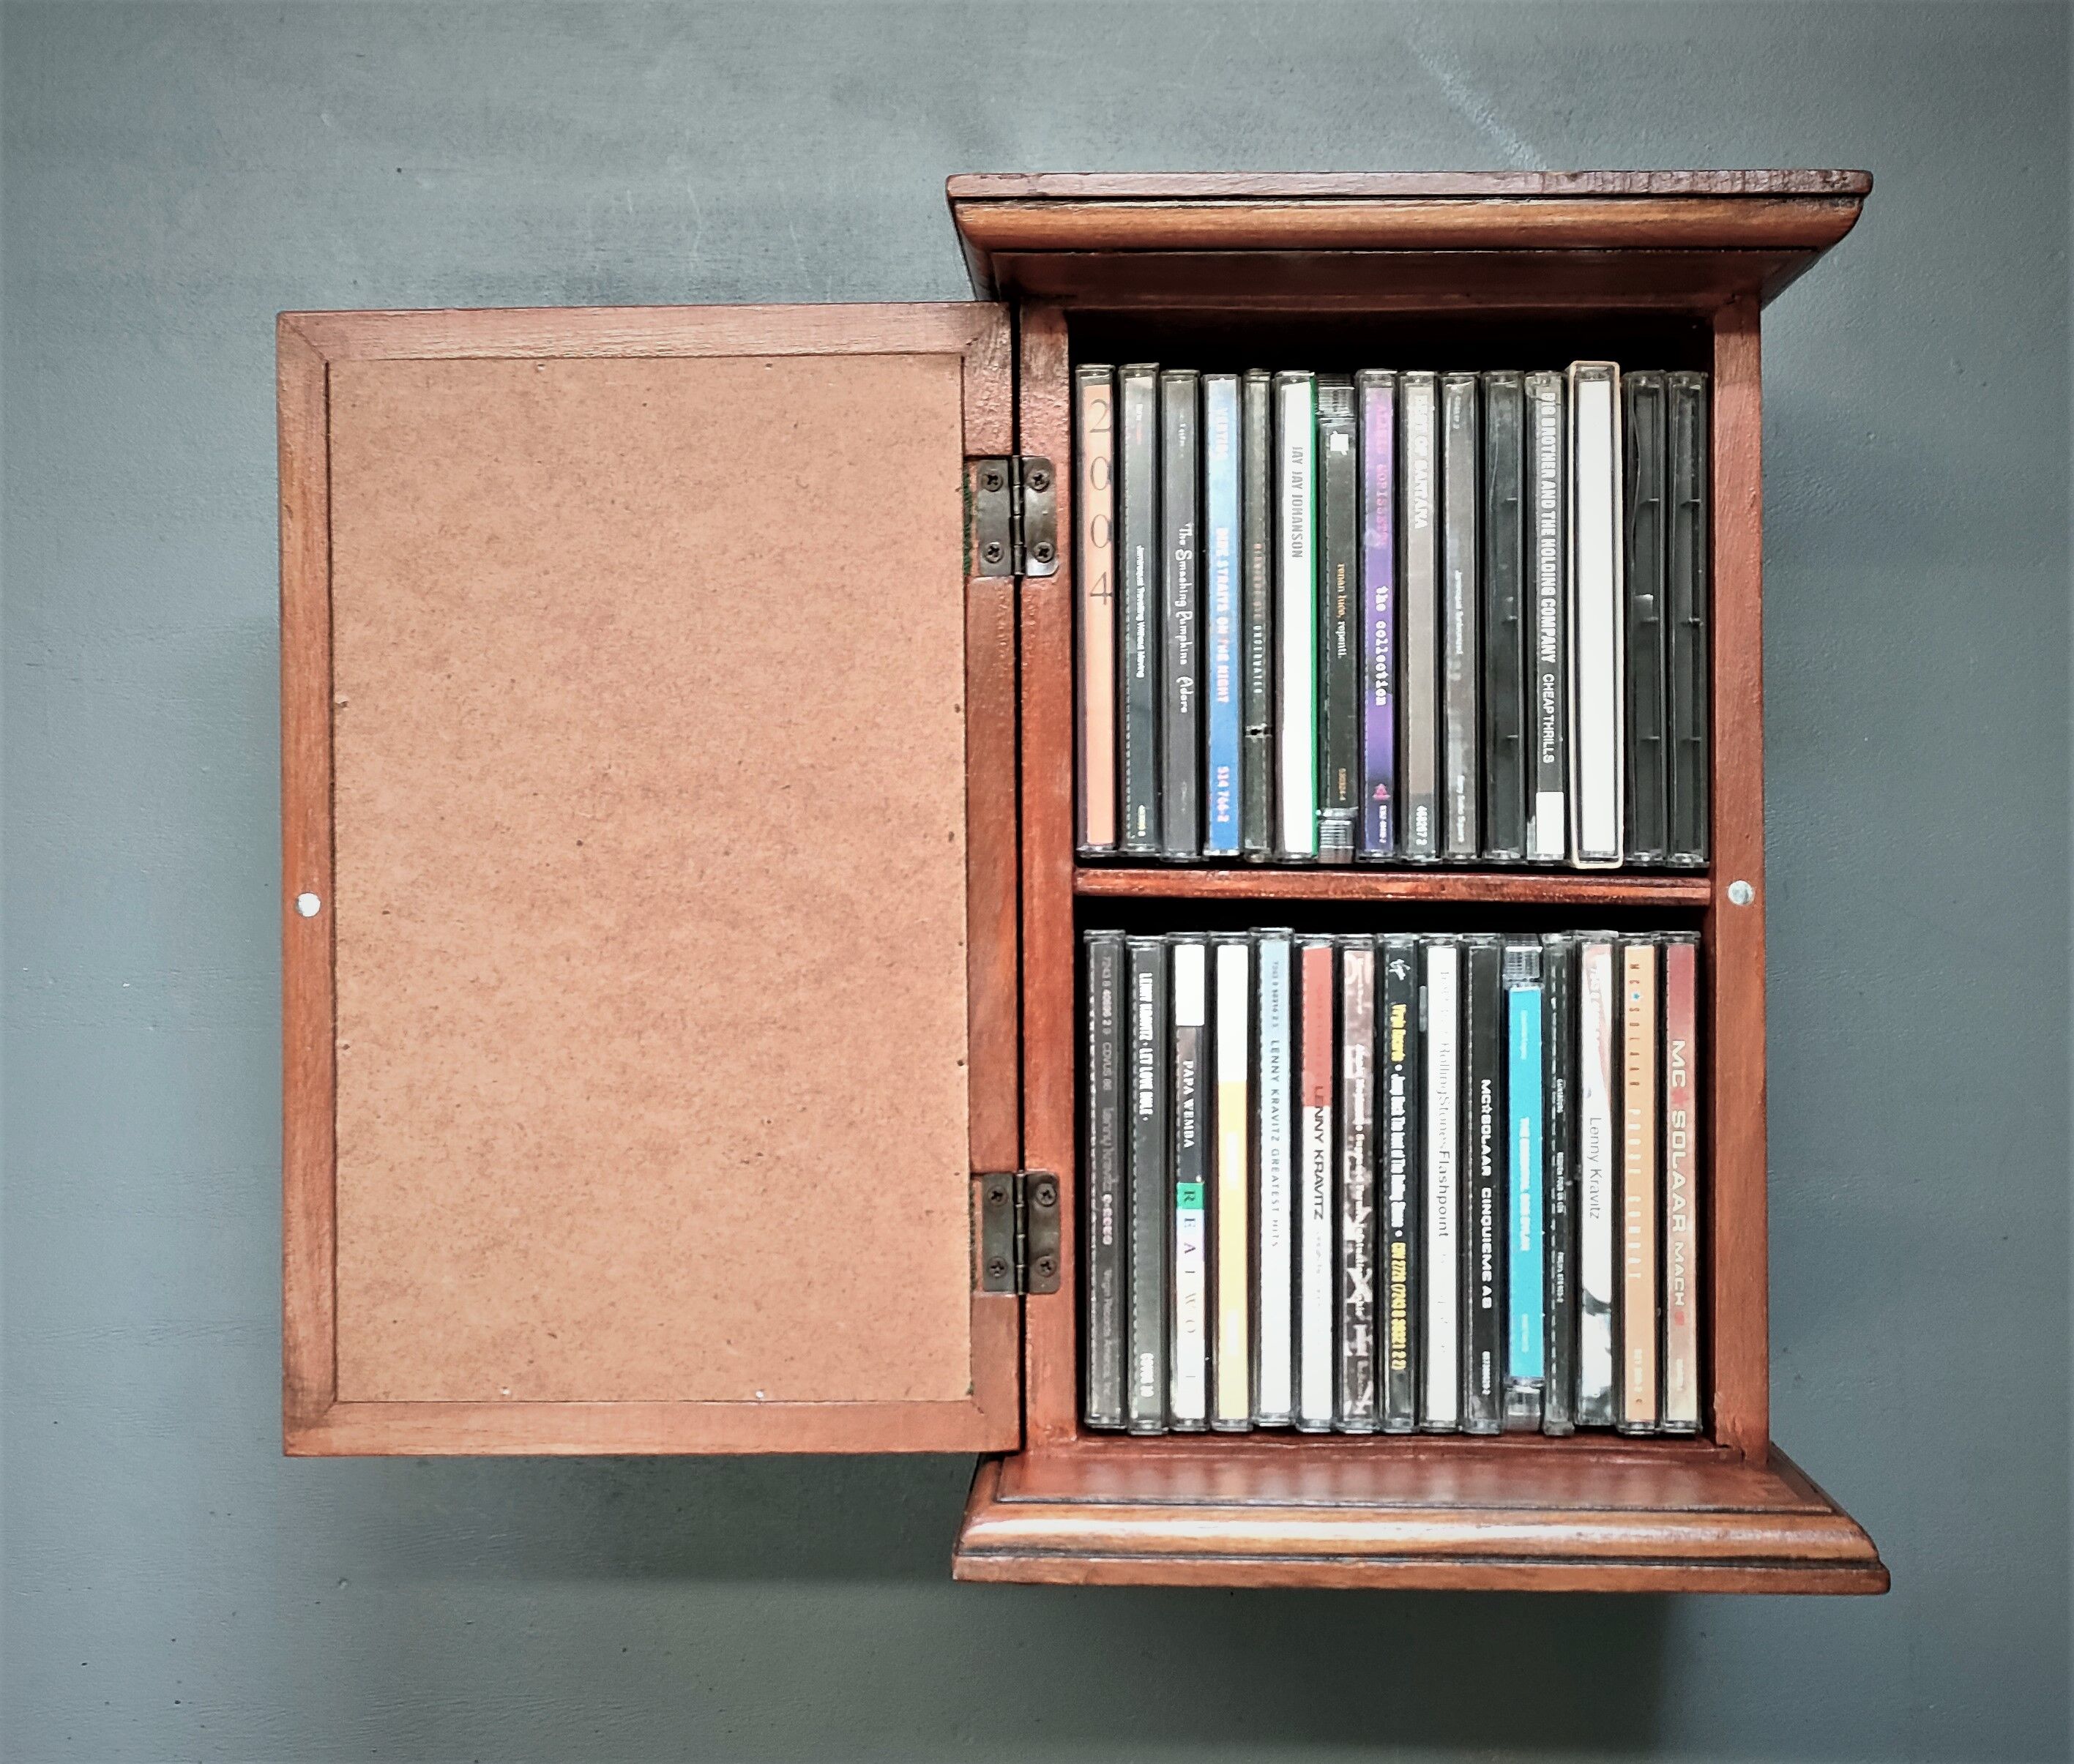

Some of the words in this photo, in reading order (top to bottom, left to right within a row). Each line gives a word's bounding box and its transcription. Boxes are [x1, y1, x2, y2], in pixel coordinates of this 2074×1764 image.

[1291, 446, 1304, 465] JAY
[1541, 418, 1556, 479] BROTHER
[1291, 471, 1304, 490] JAY
[1541, 480, 1556, 509] AND
[1291, 494, 1304, 558] JOHANSON
[1541, 511, 1556, 537] THE
[1175, 549, 1193, 608] Smashing
[1541, 538, 1556, 596] HOLDING
[1376, 586, 1389, 612] the
[1175, 610, 1193, 665] Pumpkins
[1541, 598, 1556, 663] COMPANY
[1376, 621, 1389, 706] collection
[1175, 676, 1193, 714] Adore
[1543, 673, 1555, 714] CHEAP
[1543, 715, 1555, 763] THRILLS
[1182, 1061, 1195, 1095] PAPA
[1270, 1039, 1280, 1083] LENNY
[1671, 1039, 1687, 1088] MC
[1182, 1098, 1195, 1148] WEMBA
[1270, 1088, 1280, 1142] KRAVITZ
[1314, 1085, 1324, 1143] LENNY
[1587, 1116, 1603, 1162] Lenny
[1271, 1148, 1280, 1212] GREATEST
[1314, 1149, 1324, 1220] KRAVITZ
[1438, 1150, 1451, 1238] Flashpoint
[1589, 1168, 1603, 1219] Kravitz
[1671, 1109, 1687, 1232] SOLAAR
[1674, 1241, 1685, 1307] MACH
